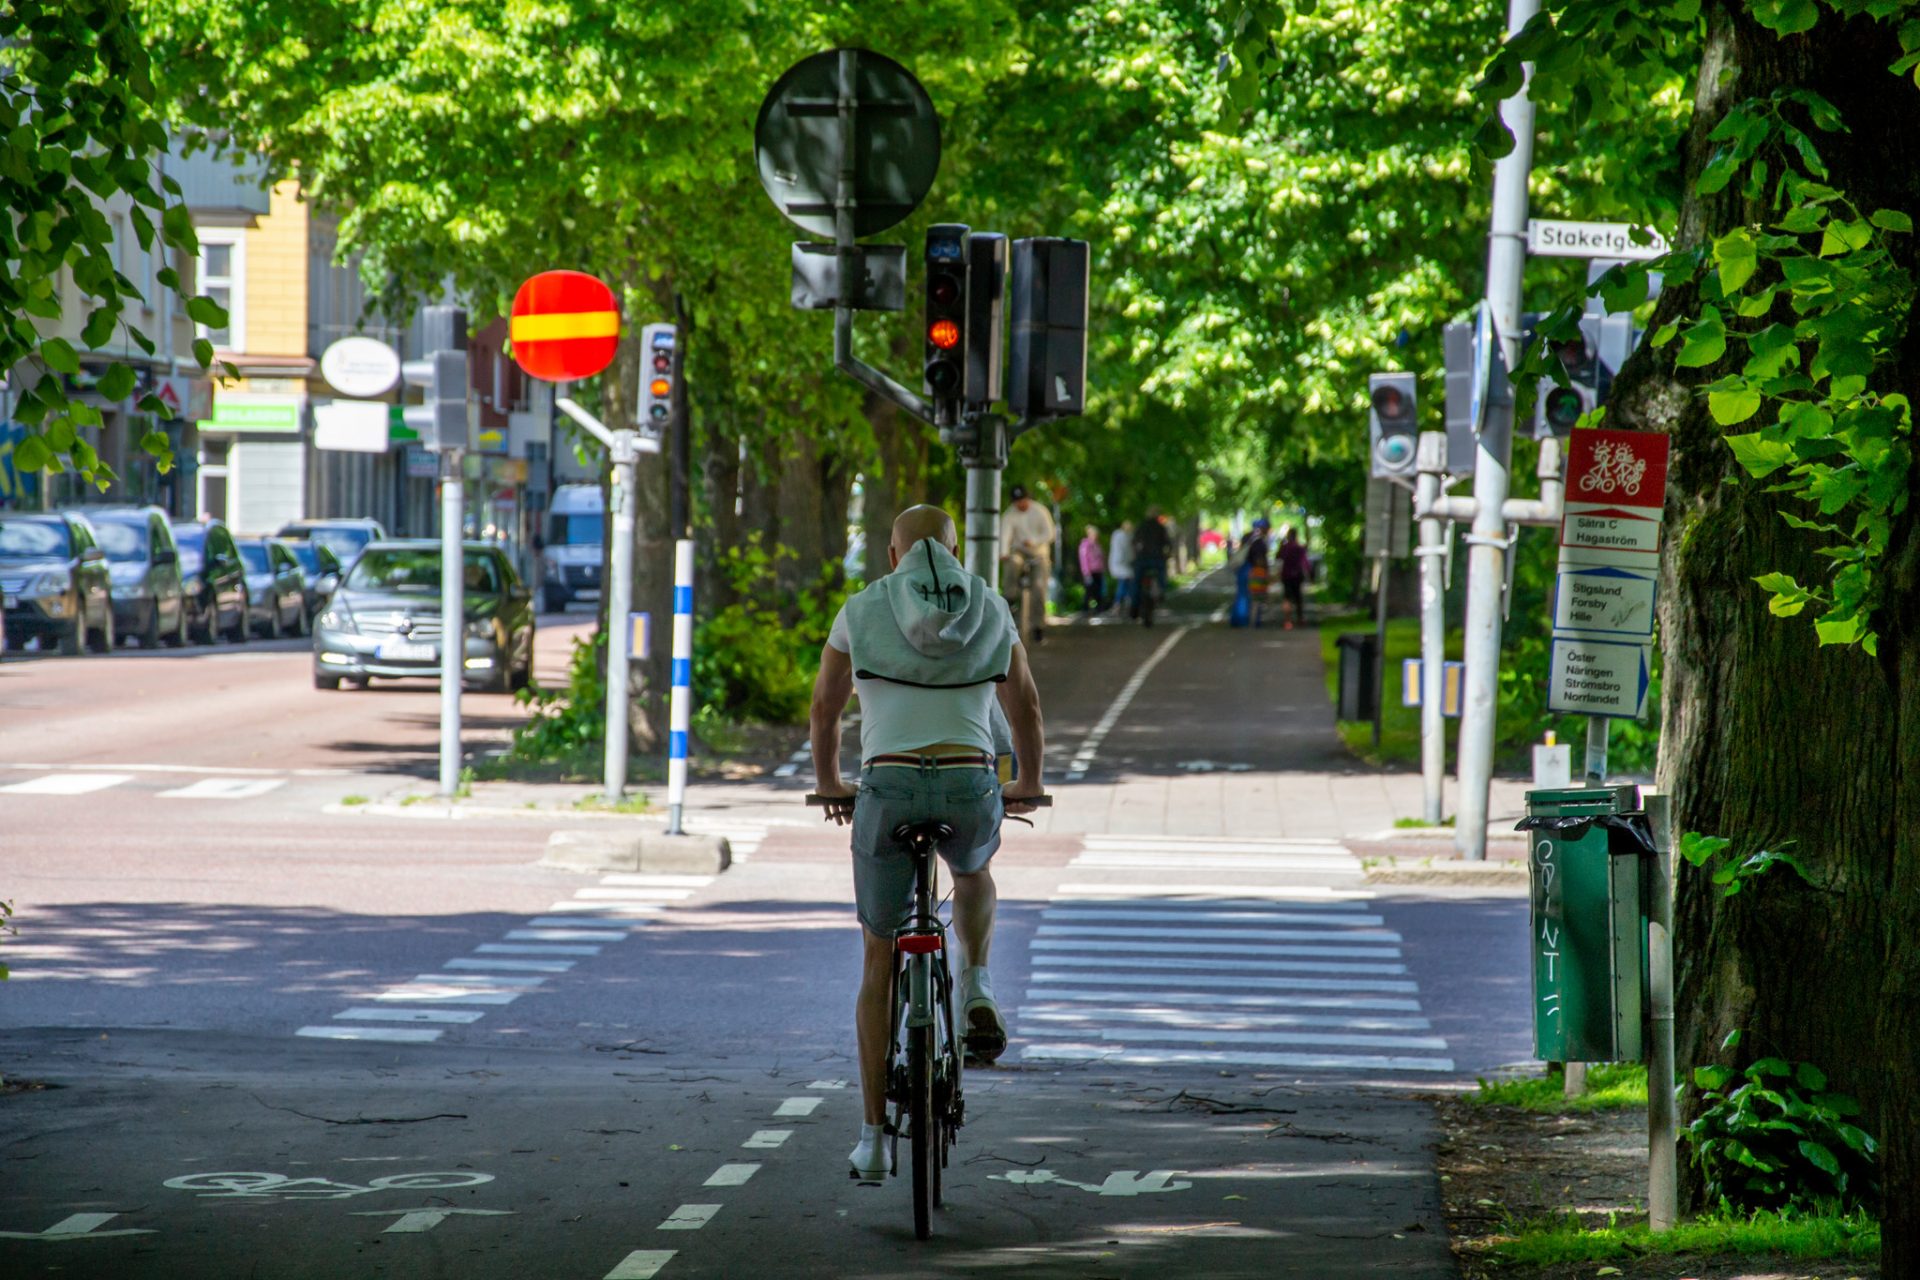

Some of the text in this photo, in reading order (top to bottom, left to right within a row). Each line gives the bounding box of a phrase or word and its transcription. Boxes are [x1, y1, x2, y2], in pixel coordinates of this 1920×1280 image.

[1542, 227, 1667, 252] Staketga
[1577, 518, 1618, 529] Sätra C
[1576, 532, 1638, 546] Hagaström
[1573, 583, 1622, 596] Stigslund
[1571, 597, 1607, 611] Forsby
[1570, 611, 1592, 622] Hille
[1567, 649, 1597, 663] Öster
[1566, 665, 1613, 679] Näringen
[1565, 678, 1621, 692] Strömsbro
[1564, 691, 1619, 705] Norrlandet
